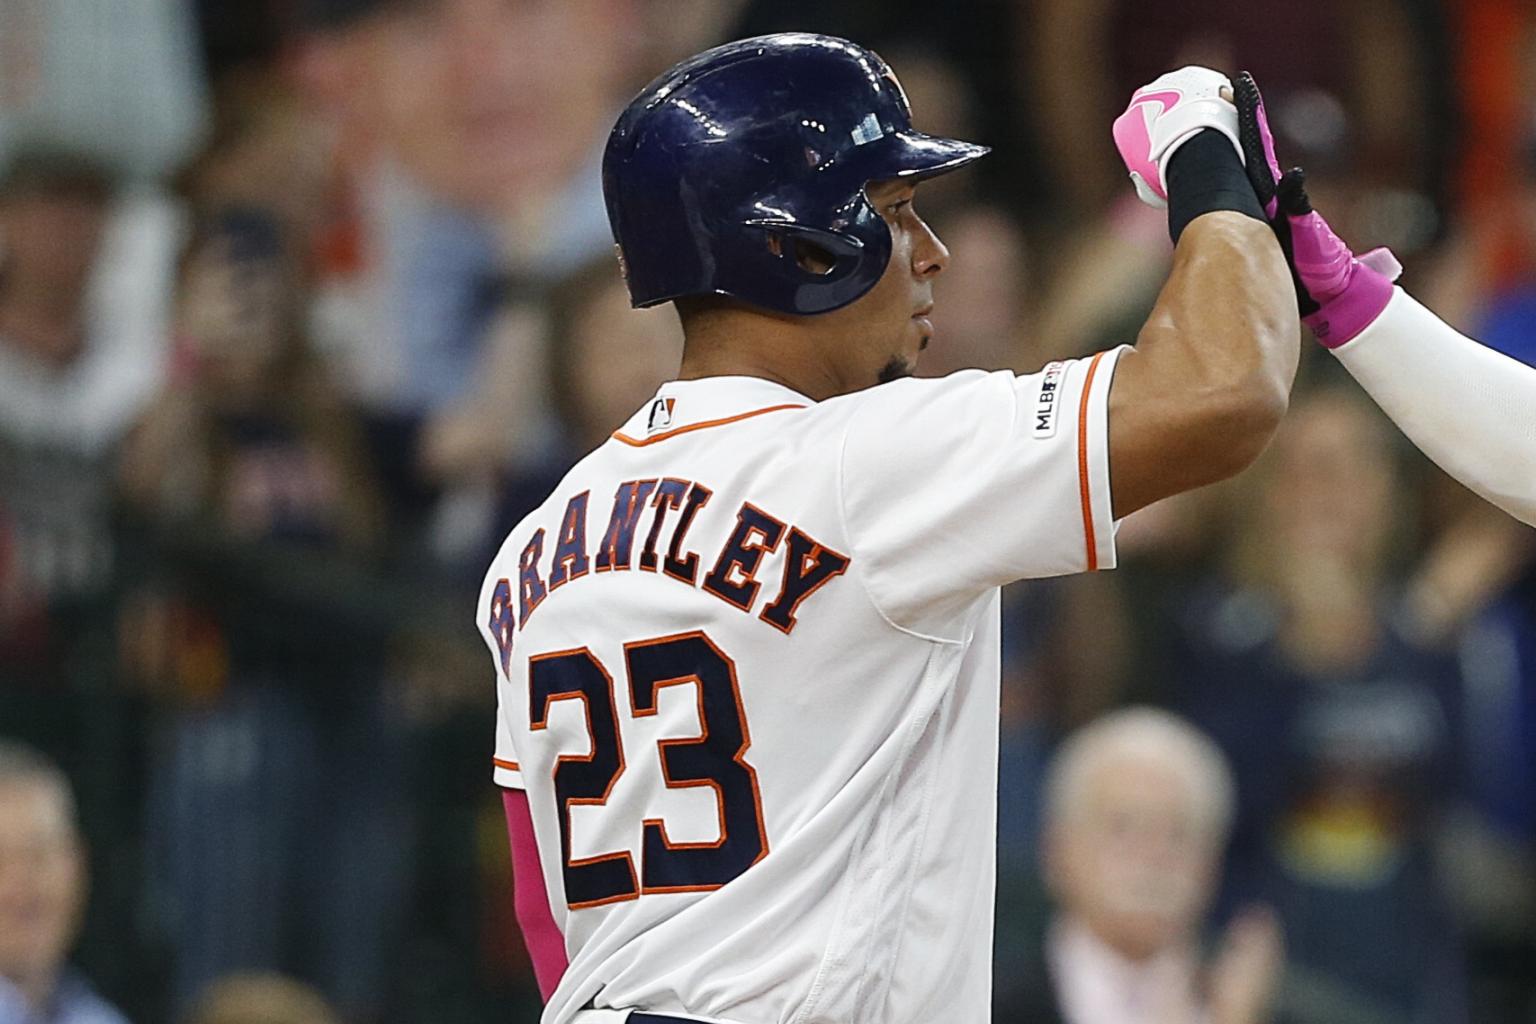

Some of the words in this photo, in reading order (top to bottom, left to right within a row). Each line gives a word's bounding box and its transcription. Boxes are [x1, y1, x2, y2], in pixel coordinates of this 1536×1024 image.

[1035, 391, 1055, 431] MLB
[488, 477, 851, 680] BRANTLEY
[529, 630, 769, 910] 23
